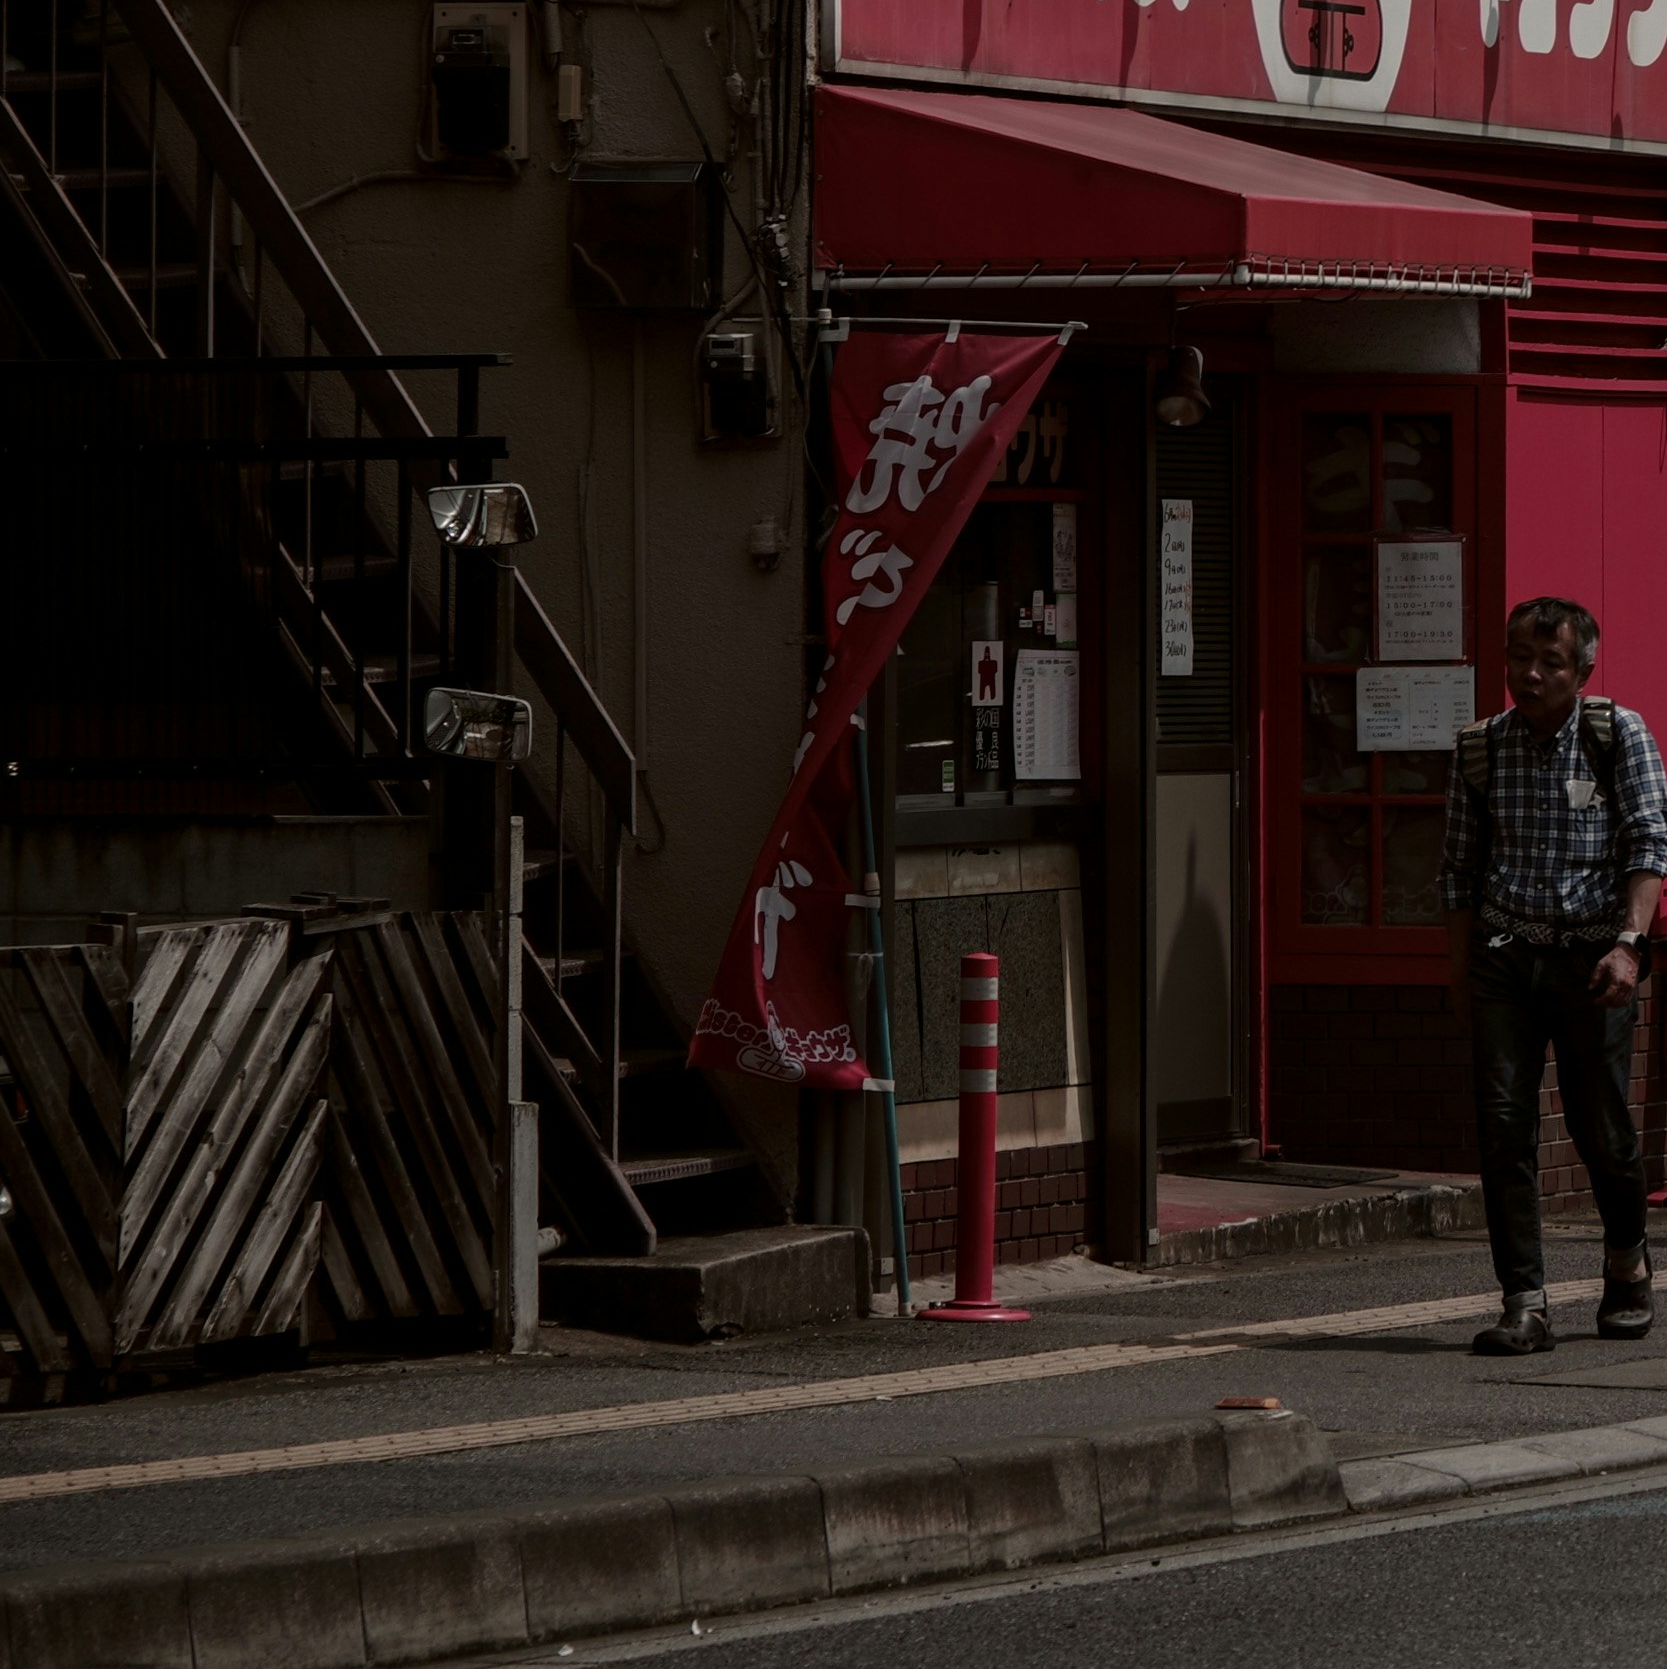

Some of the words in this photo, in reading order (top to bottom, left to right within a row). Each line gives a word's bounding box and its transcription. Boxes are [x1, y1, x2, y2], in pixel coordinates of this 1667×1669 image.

[1400, 551, 1439, 563] 営業時間
[785, 1023, 850, 1063] ギョウザ
